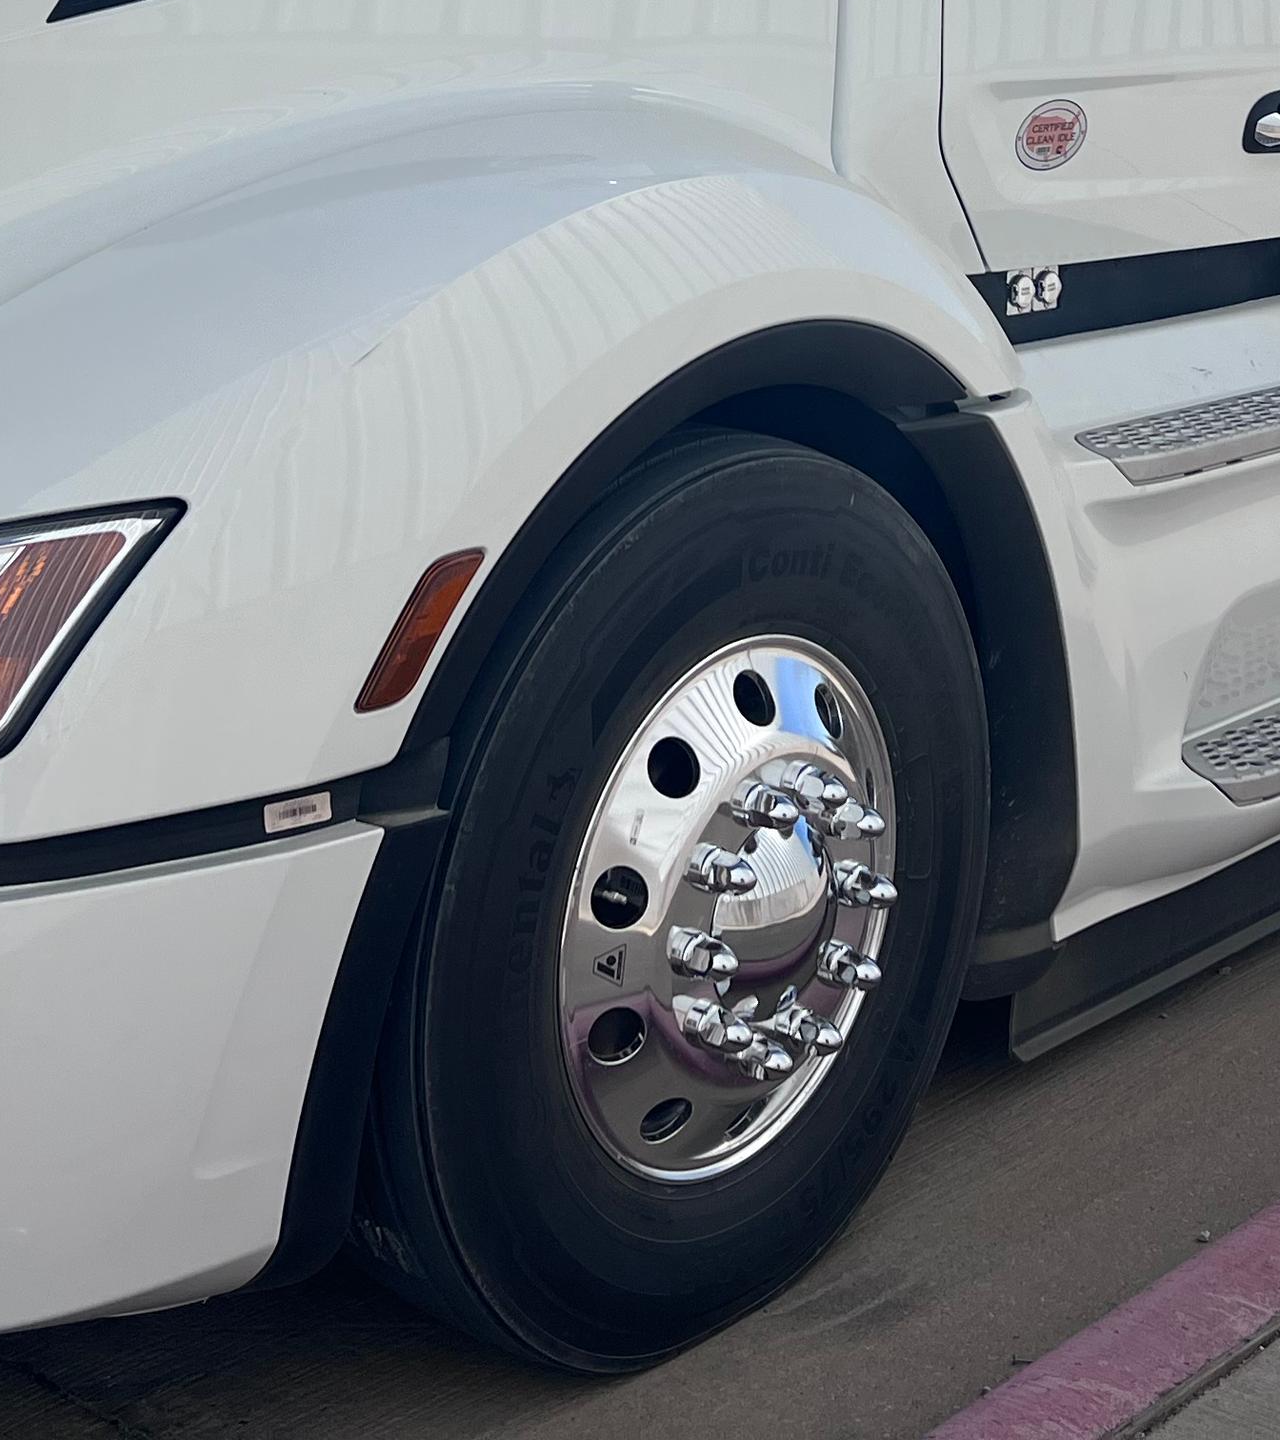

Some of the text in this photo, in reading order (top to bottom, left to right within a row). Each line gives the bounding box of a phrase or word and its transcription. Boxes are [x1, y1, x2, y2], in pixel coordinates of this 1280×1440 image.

[1032, 122, 1075, 133] CERTIFIED
[1026, 132, 1076, 146] CLEAN IDLE
